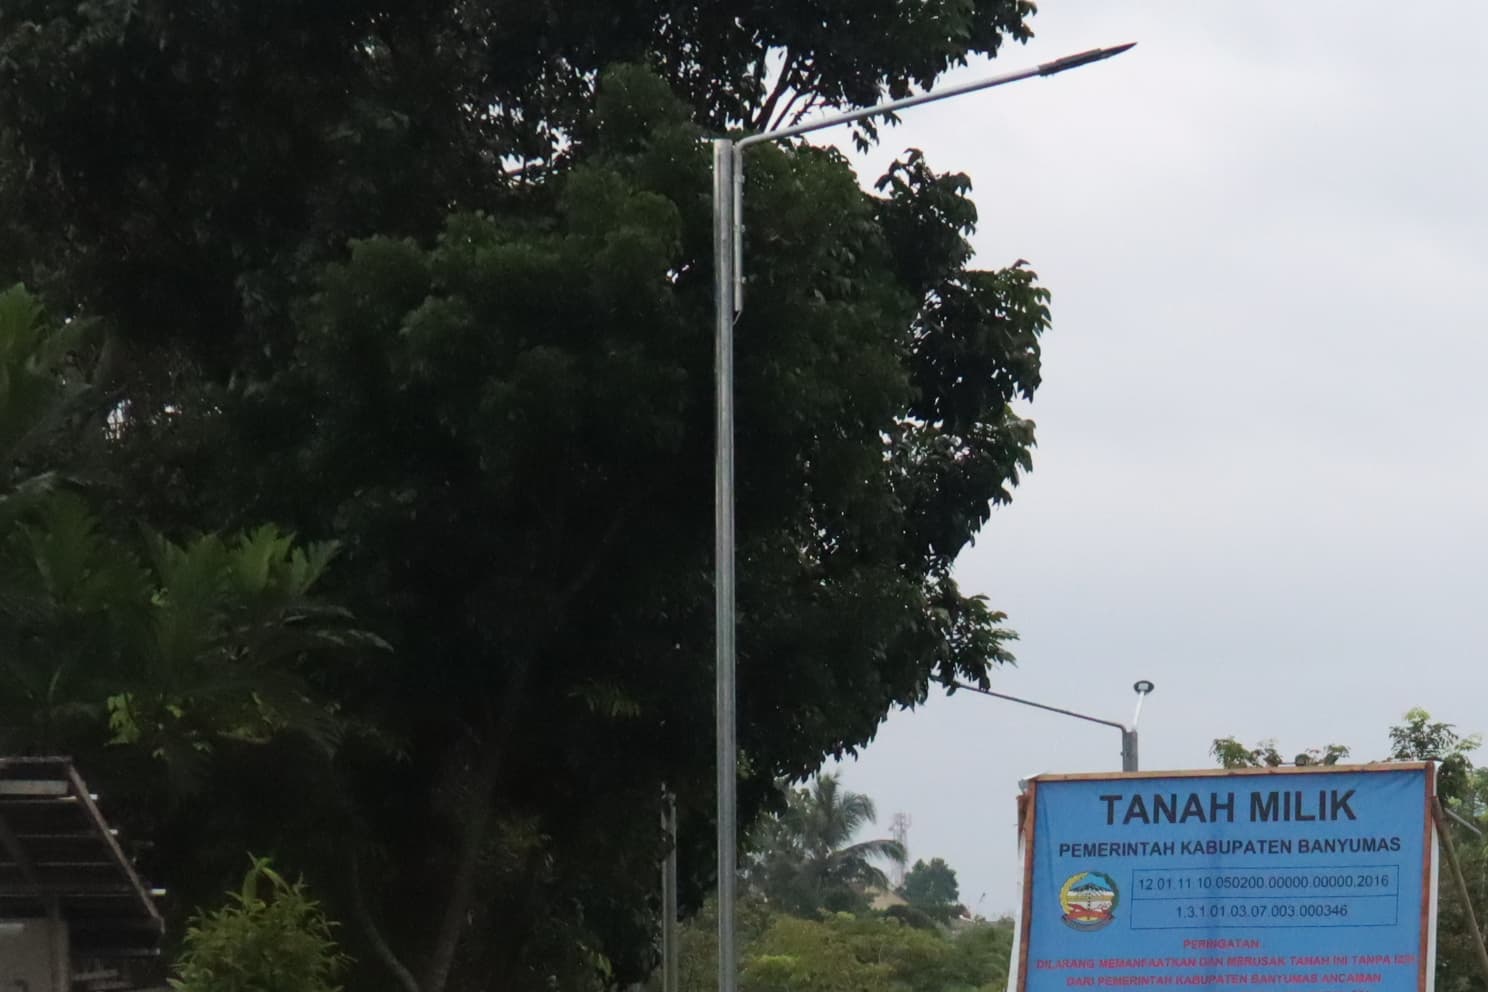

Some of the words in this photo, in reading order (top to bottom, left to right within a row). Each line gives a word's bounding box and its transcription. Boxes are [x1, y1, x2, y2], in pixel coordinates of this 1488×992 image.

[1100, 792, 1234, 825] TANAH
[1250, 790, 1357, 822] MILIK
[1059, 842, 1175, 858] PEMERINTAH
[1181, 839, 1292, 857] KABUPATEN
[1299, 837, 1401, 855] BANYUMAS
[1183, 938, 1260, 950] PERINGATAN
[1036, 959, 1095, 970] DILARANG
[1227, 955, 1287, 967] MERUSAK
[1290, 955, 1330, 967] TANAH
[1333, 954, 1348, 966] INI
[1352, 954, 1391, 966] TANPA
[1097, 975, 1173, 987] PEMERINTAH
[1175, 974, 1248, 986] KABUPATEN
